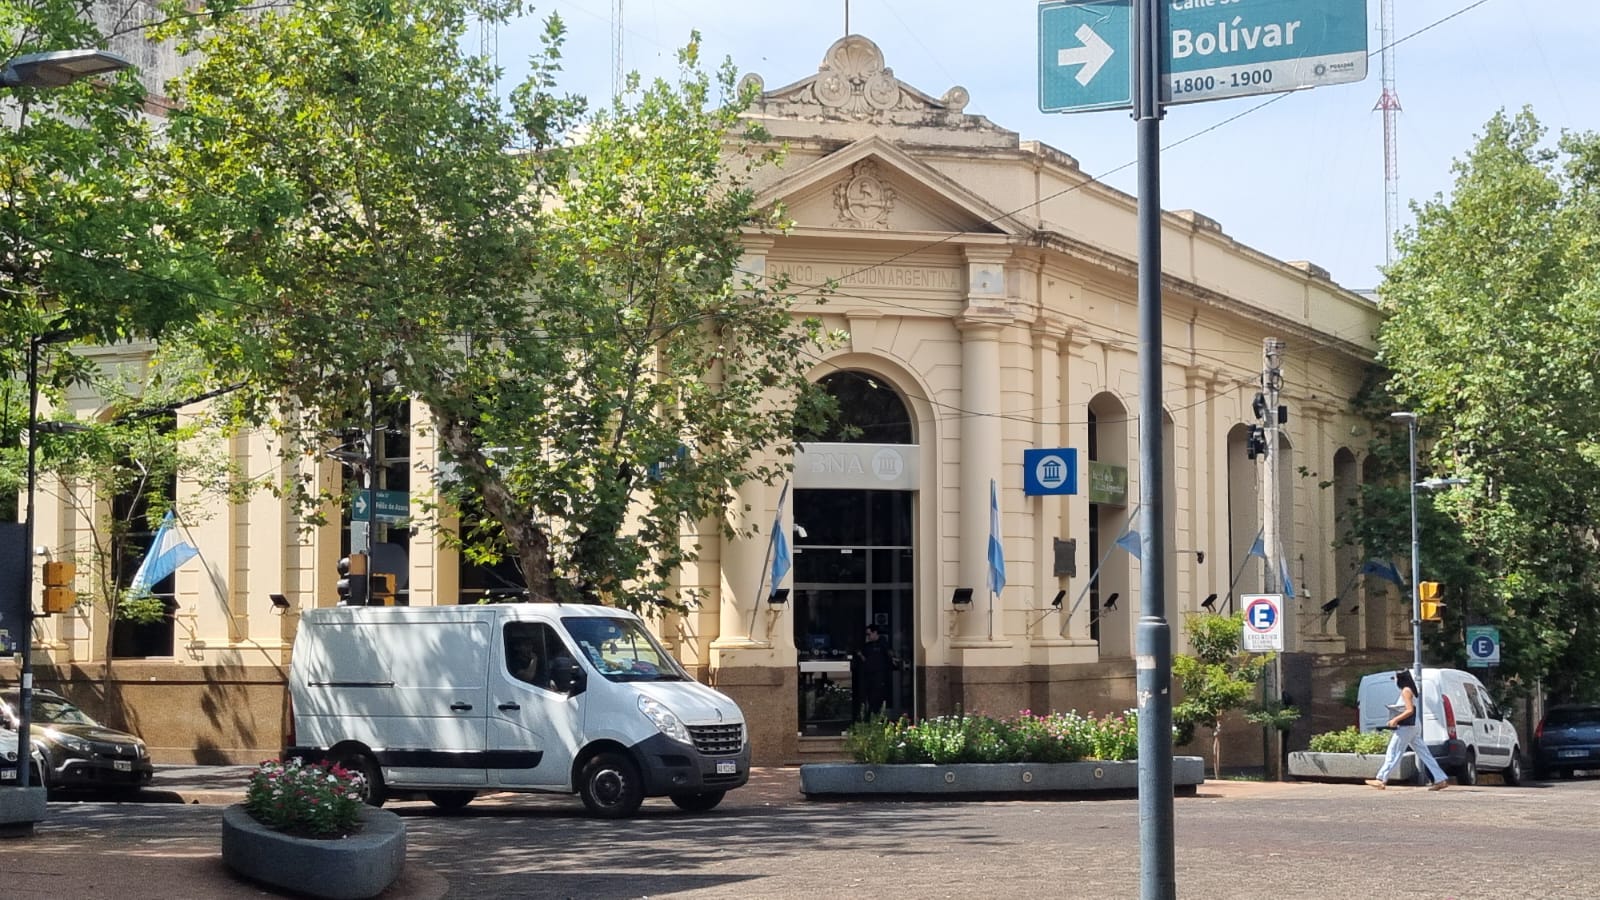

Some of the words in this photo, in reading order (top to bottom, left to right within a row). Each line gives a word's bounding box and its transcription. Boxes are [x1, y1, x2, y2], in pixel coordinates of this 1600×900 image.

[1172, 16, 1301, 59] Bolívar
[1173, 75, 1215, 94] 1800
[1230, 68, 1273, 88] 1900
[769, 264, 813, 282] BANCO
[887, 268, 956, 288] ARGENTINA
[806, 451, 865, 474] BNA
[1254, 604, 1270, 628] E
[1478, 640, 1488, 654] E
